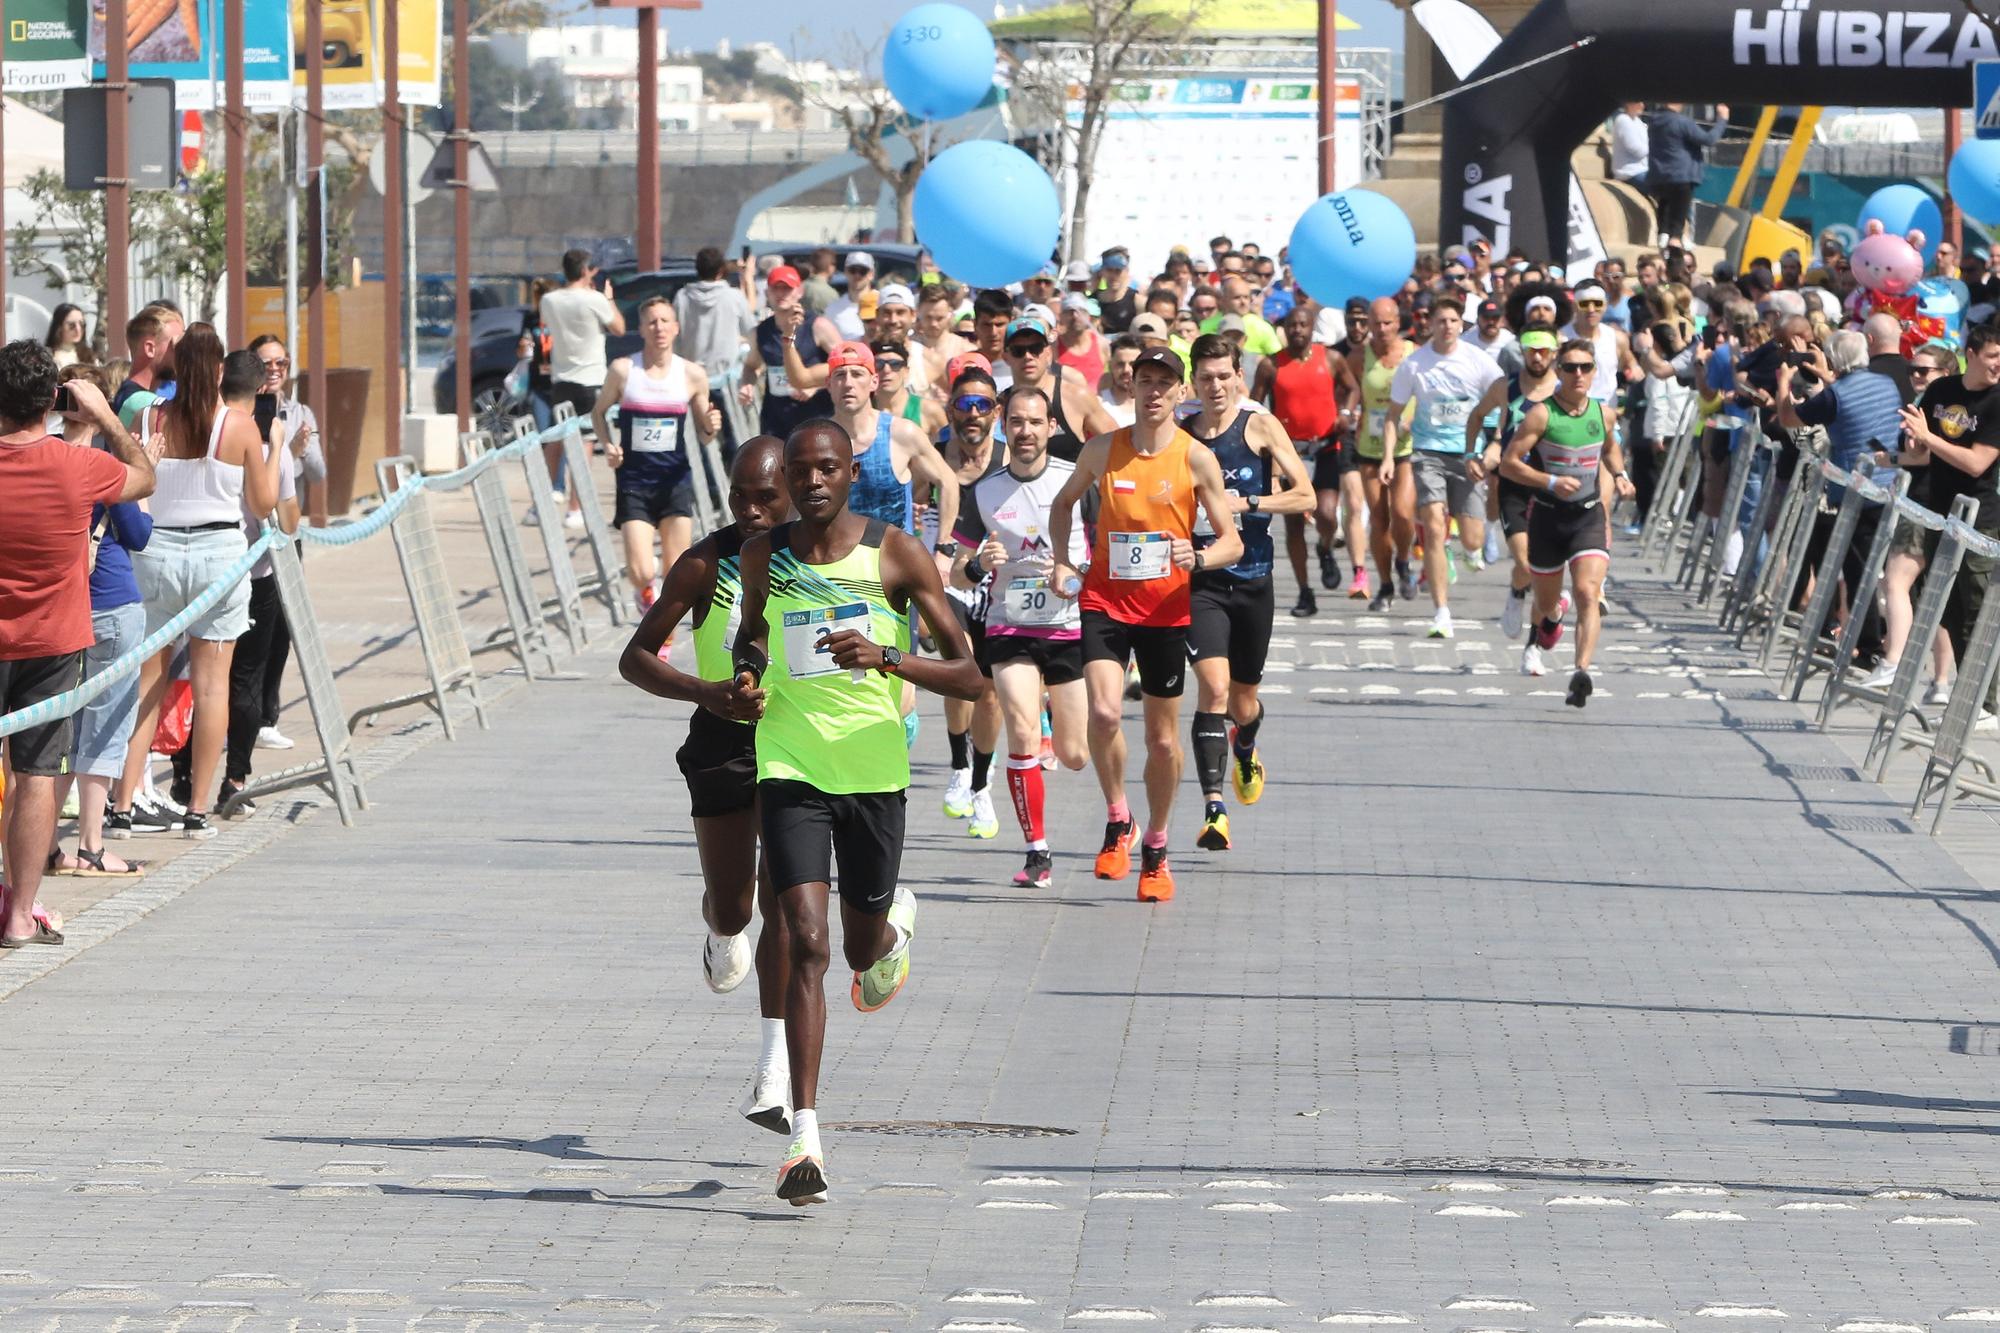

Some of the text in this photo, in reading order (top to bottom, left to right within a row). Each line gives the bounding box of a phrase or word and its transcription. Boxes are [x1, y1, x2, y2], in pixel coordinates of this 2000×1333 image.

[28, 22, 67, 30] NATIONAL
[27, 31, 76, 40] GEOGRAPHIC
[643, 429, 661, 441] 24
[1130, 546, 1142, 565] 8
[1021, 592, 1046, 610] 30
[815, 627, 831, 654] 2
